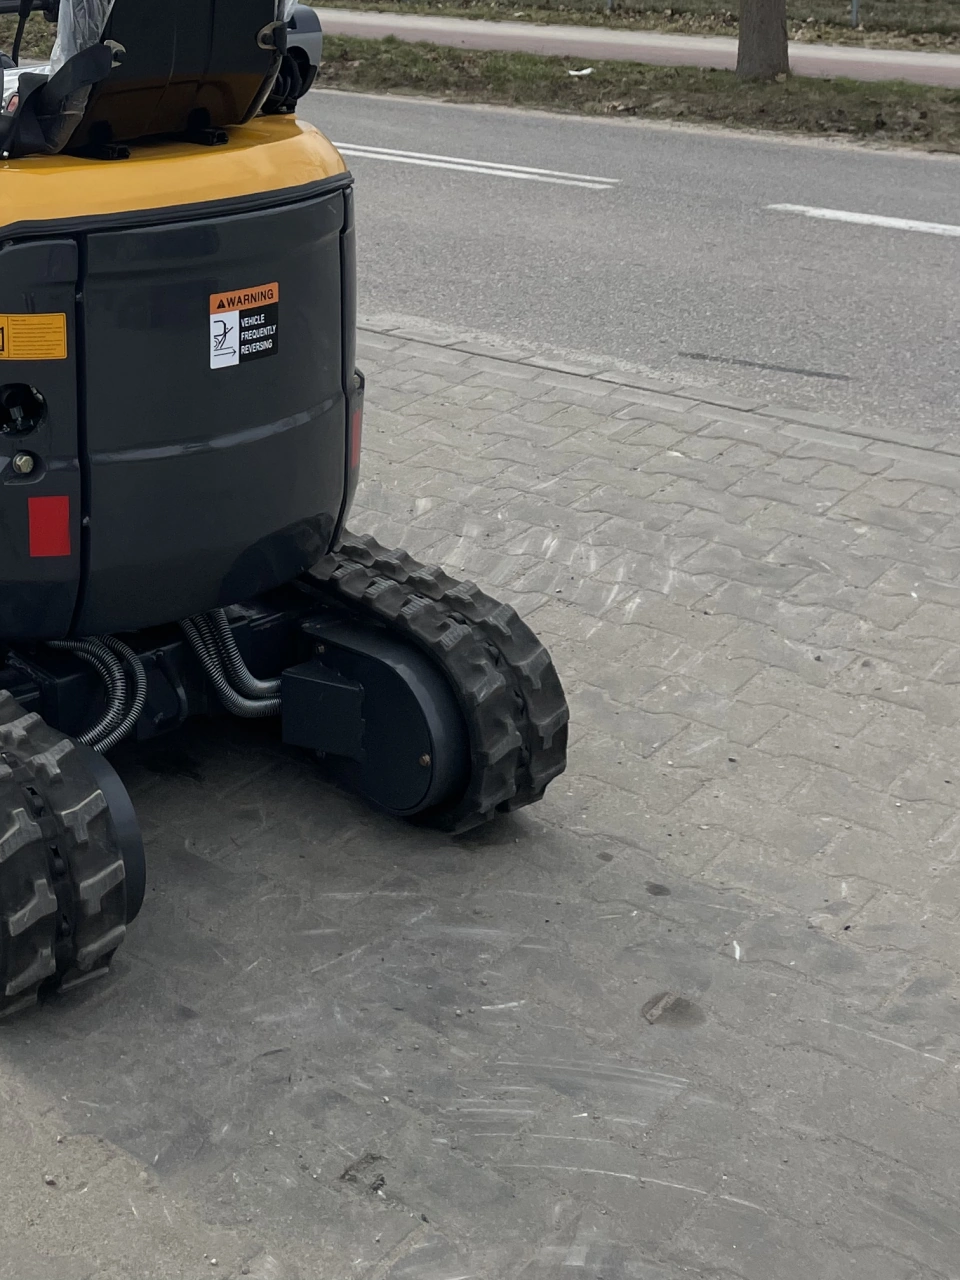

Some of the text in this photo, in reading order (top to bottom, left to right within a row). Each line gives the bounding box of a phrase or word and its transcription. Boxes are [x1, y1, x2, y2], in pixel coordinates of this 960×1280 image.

[226, 288, 274, 308] WARNING
[240, 314, 265, 327] VEHICLE
[240, 325, 277, 341] FREQUENTLY
[240, 339, 273, 355] REVERSING
